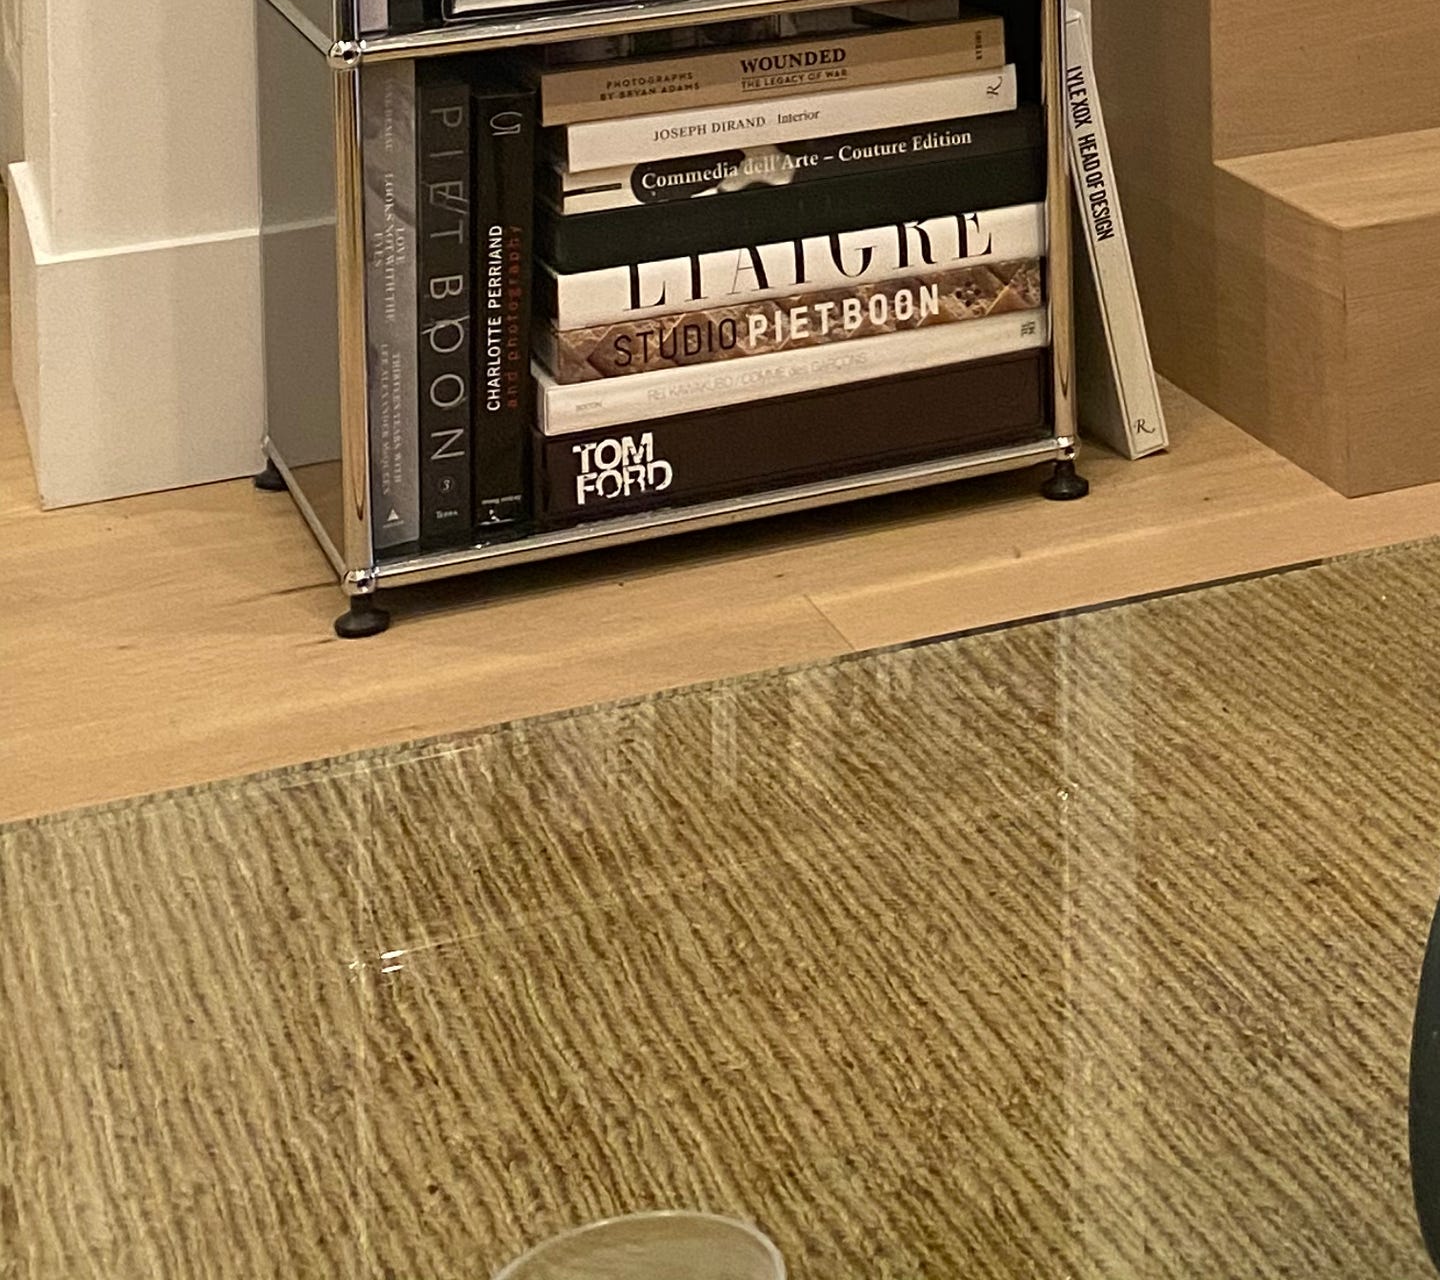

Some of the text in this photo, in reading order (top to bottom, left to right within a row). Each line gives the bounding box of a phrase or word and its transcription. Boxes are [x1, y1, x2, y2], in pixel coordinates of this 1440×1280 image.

[740, 47, 847, 74] WOUNDED
[741, 78, 762, 89] THE
[764, 73, 806, 88] LEGACY
[826, 68, 848, 80] WAR
[599, 81, 700, 102] BY BRYAN ADAMS
[606, 72, 694, 89] PHOTOGRAPHS
[653, 109, 821, 142] JOSEPH DIRAND Interior
[1071, 98, 1092, 129] XOX
[641, 161, 739, 191] Commedia
[743, 151, 819, 177] dell'Arte
[838, 139, 908, 163] Couture
[912, 129, 973, 152] Edition
[1077, 133, 1101, 173] HEAD
[1085, 172, 1105, 190] OF
[1089, 190, 1114, 242] DESIGN
[487, 225, 503, 411] CHARLOTTE PERRIAND
[613, 317, 737, 369] STUDIO
[573, 432, 654, 474] TOM
[576, 460, 673, 505] FORD
